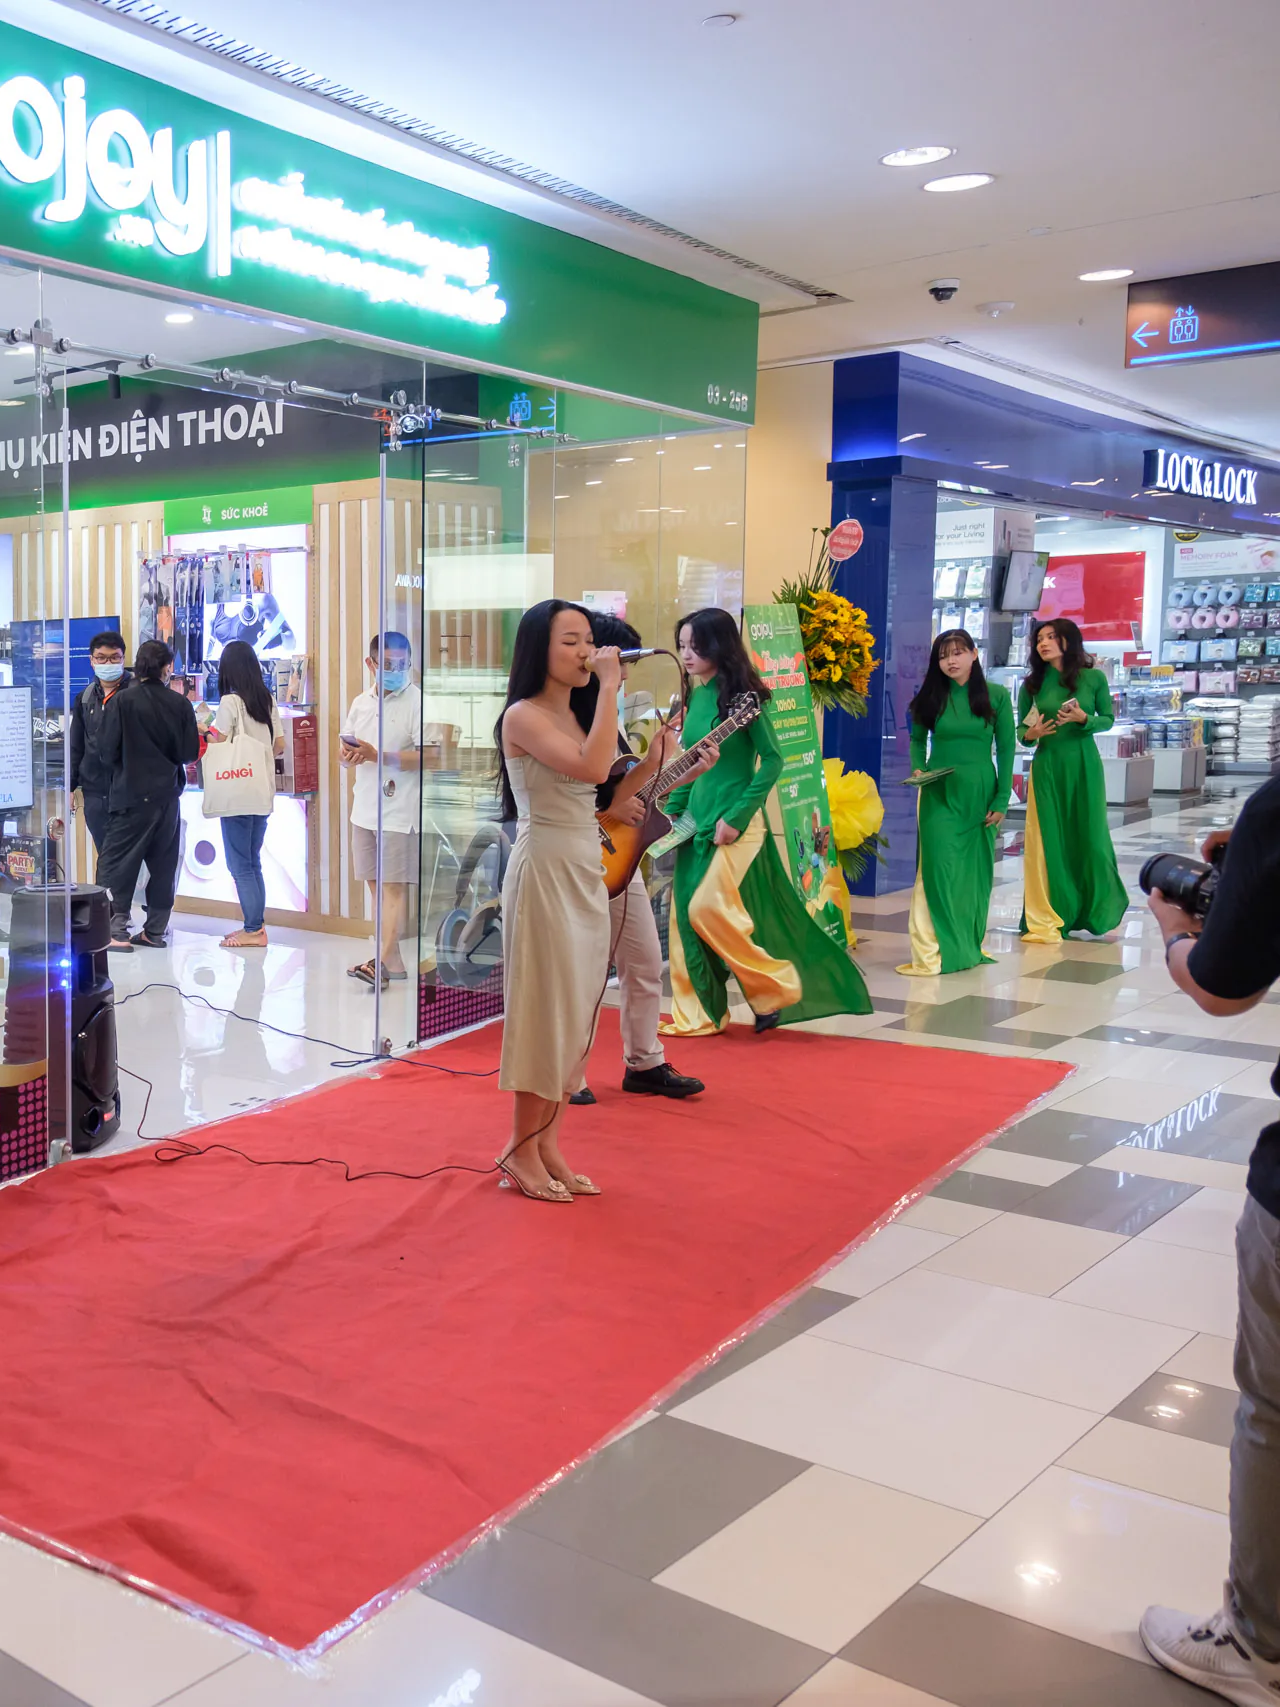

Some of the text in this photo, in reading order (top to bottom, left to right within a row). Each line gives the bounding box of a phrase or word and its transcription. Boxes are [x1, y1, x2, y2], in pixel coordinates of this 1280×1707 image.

[707, 383, 720, 406] 03
[728, 389, 749, 412] 25B
[98, 408, 170, 463] ĐIỆN
[177, 398, 285, 448] THOẠI
[1155, 448, 1258, 505] LOCK&LOCK
[221, 507, 240, 520] SỨC
[952, 522, 985, 532] Just right
[946, 533, 962, 541] your
[963, 530, 985, 539] Living
[750, 622, 774, 640] gojoy
[776, 698, 797, 712] 10h00
[7, 854, 35, 868] PARTY
